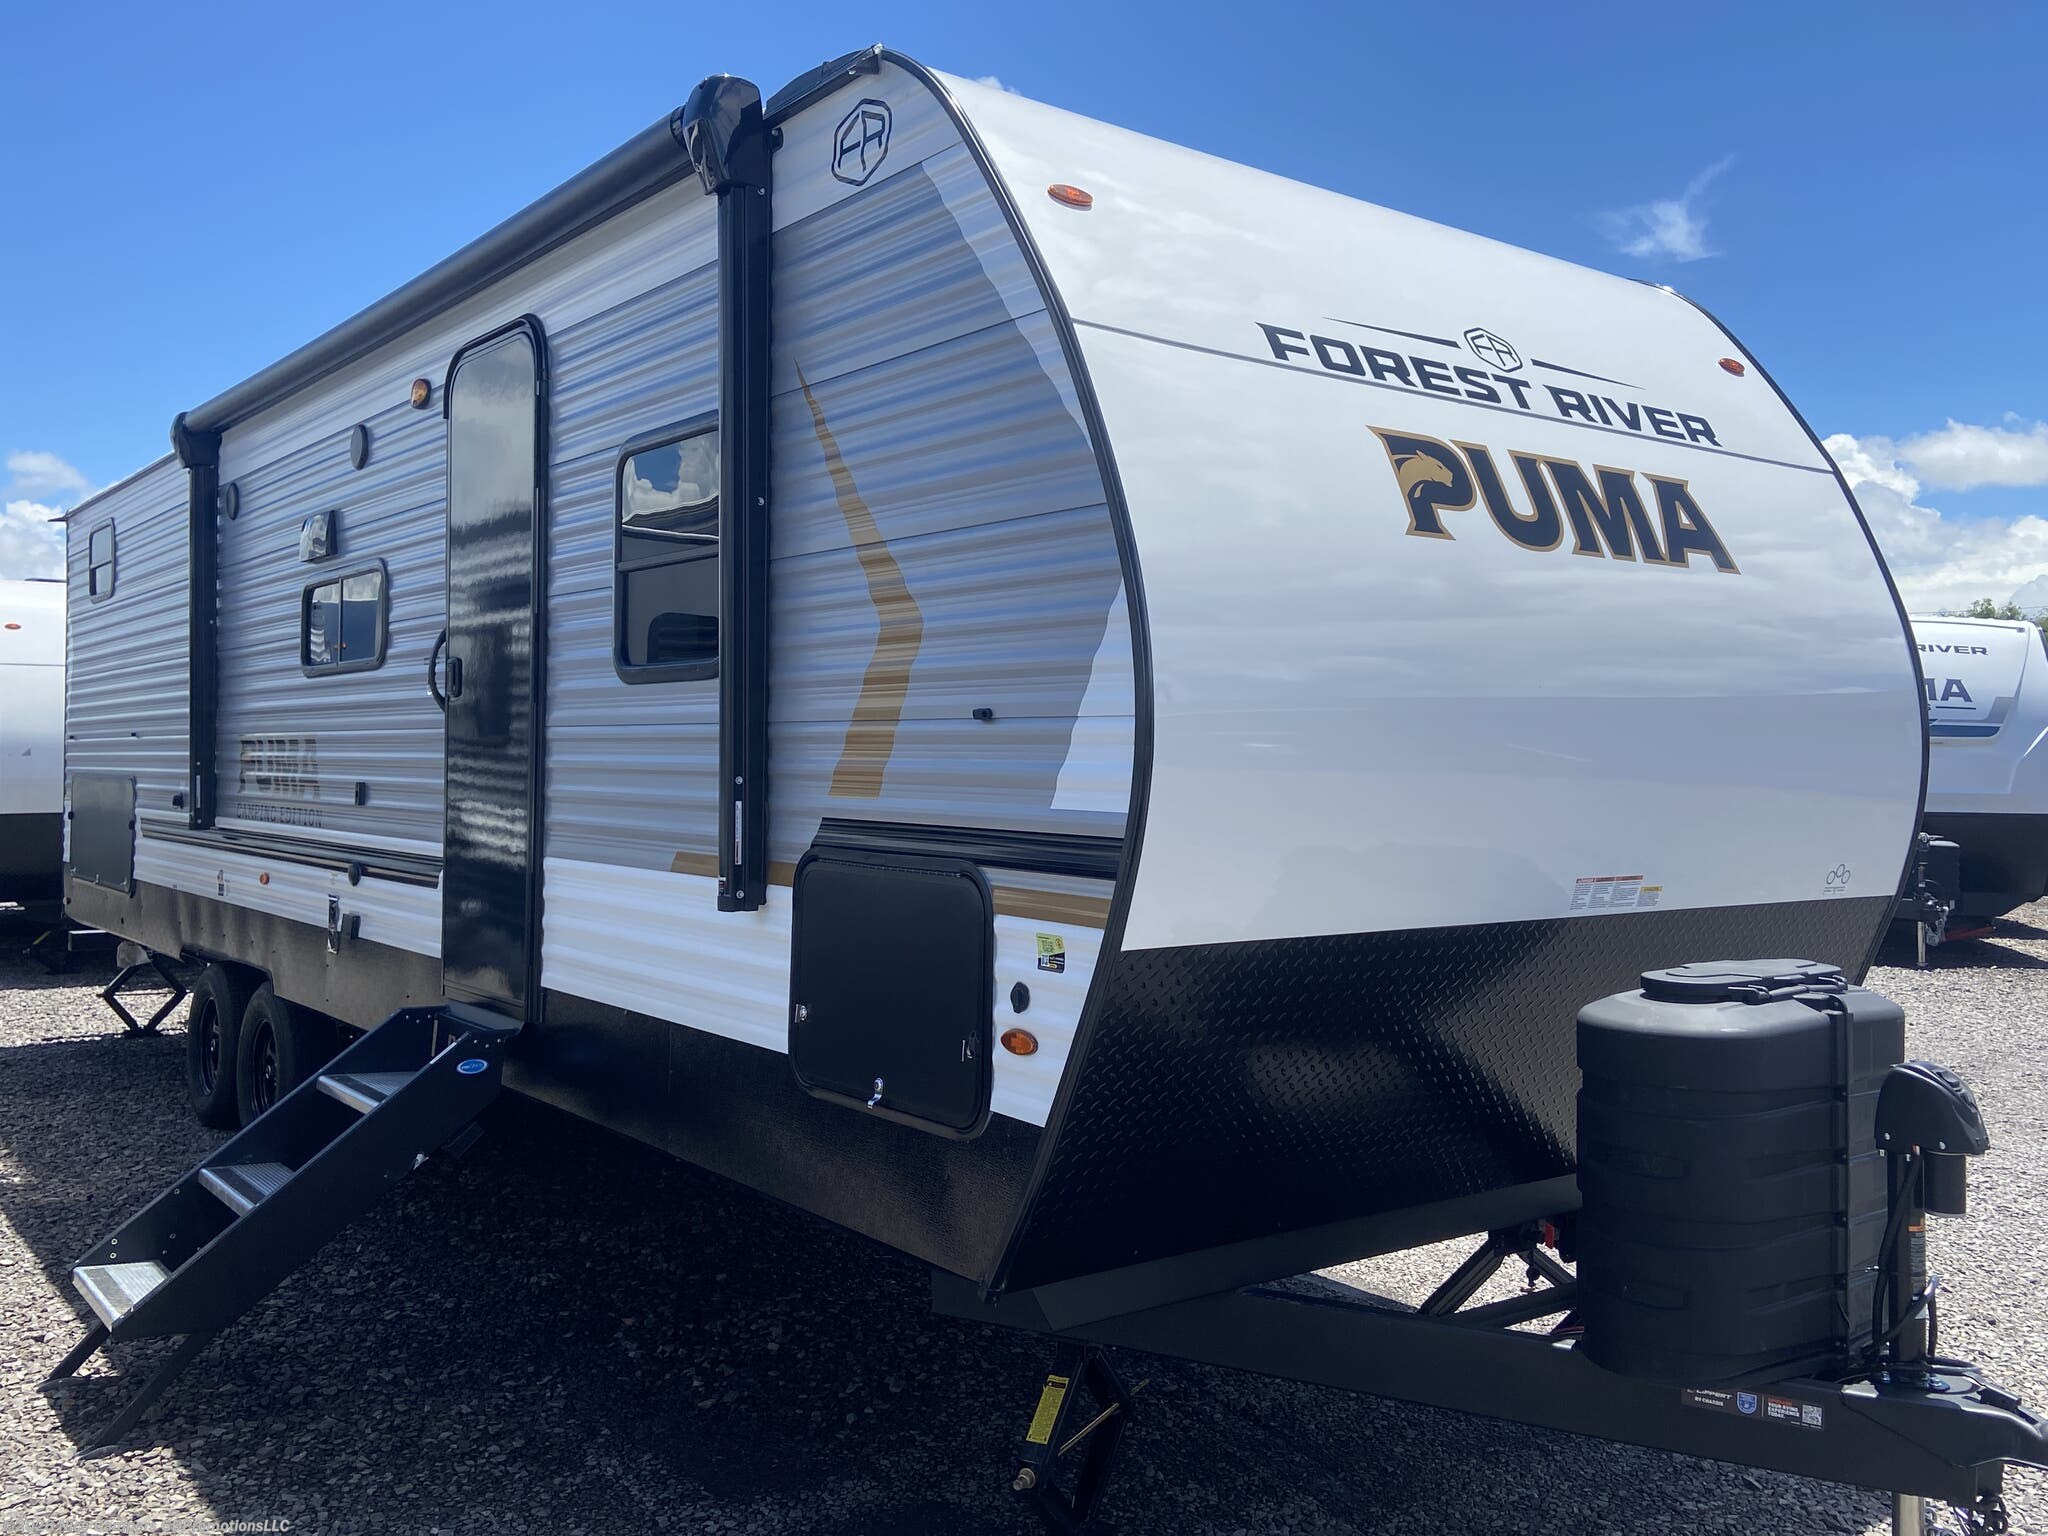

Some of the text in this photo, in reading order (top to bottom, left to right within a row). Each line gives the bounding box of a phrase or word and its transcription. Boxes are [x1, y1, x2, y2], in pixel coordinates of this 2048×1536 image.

[1255, 322, 1723, 447] FOREST RIVER
[1366, 425, 1742, 575] PUMA
[279, 806, 322, 828] EDITION
